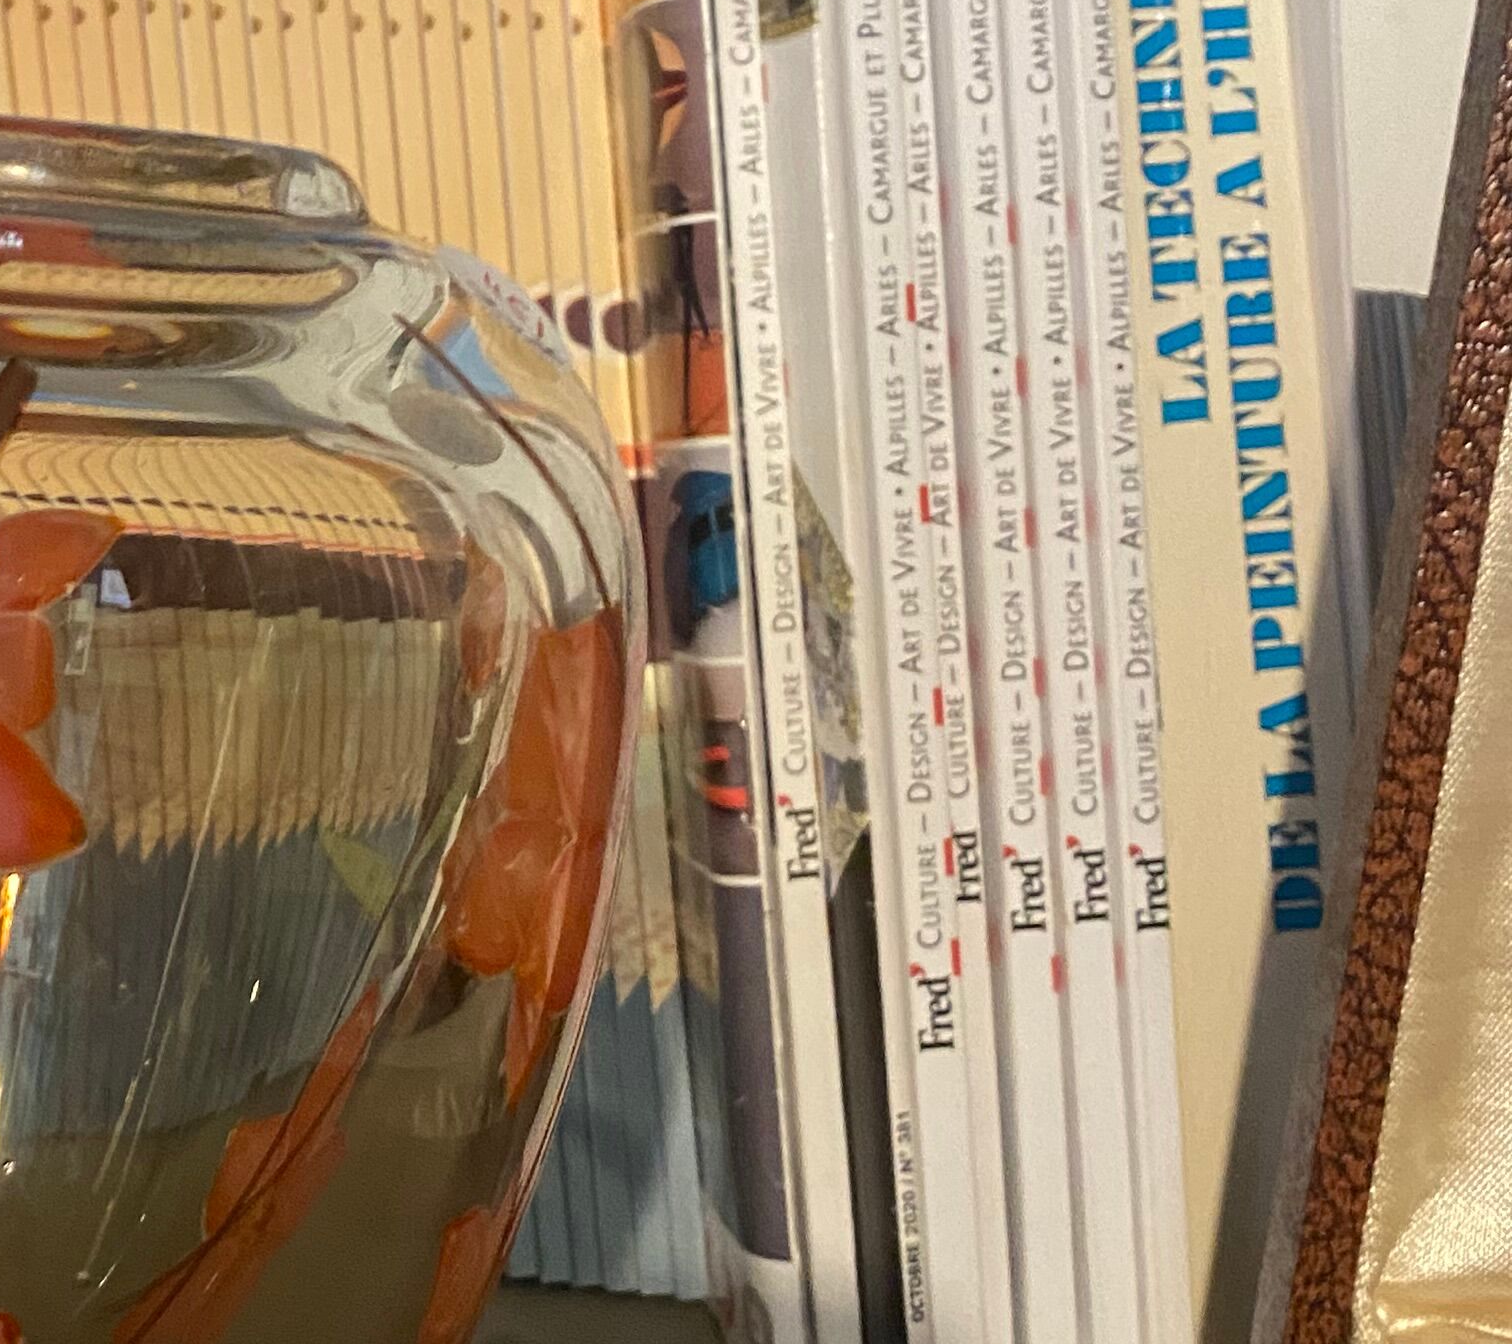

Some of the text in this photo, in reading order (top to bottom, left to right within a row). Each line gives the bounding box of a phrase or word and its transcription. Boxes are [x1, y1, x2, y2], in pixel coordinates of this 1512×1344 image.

[1156, 318, 1213, 424] LA
[1218, 232, 1305, 673] PEINTURE
[1255, 691, 1317, 802] LA
[1267, 819, 1326, 933] DE
[903, 1190, 921, 1236] 2020
[906, 1241, 925, 1323] OCTOBRE
